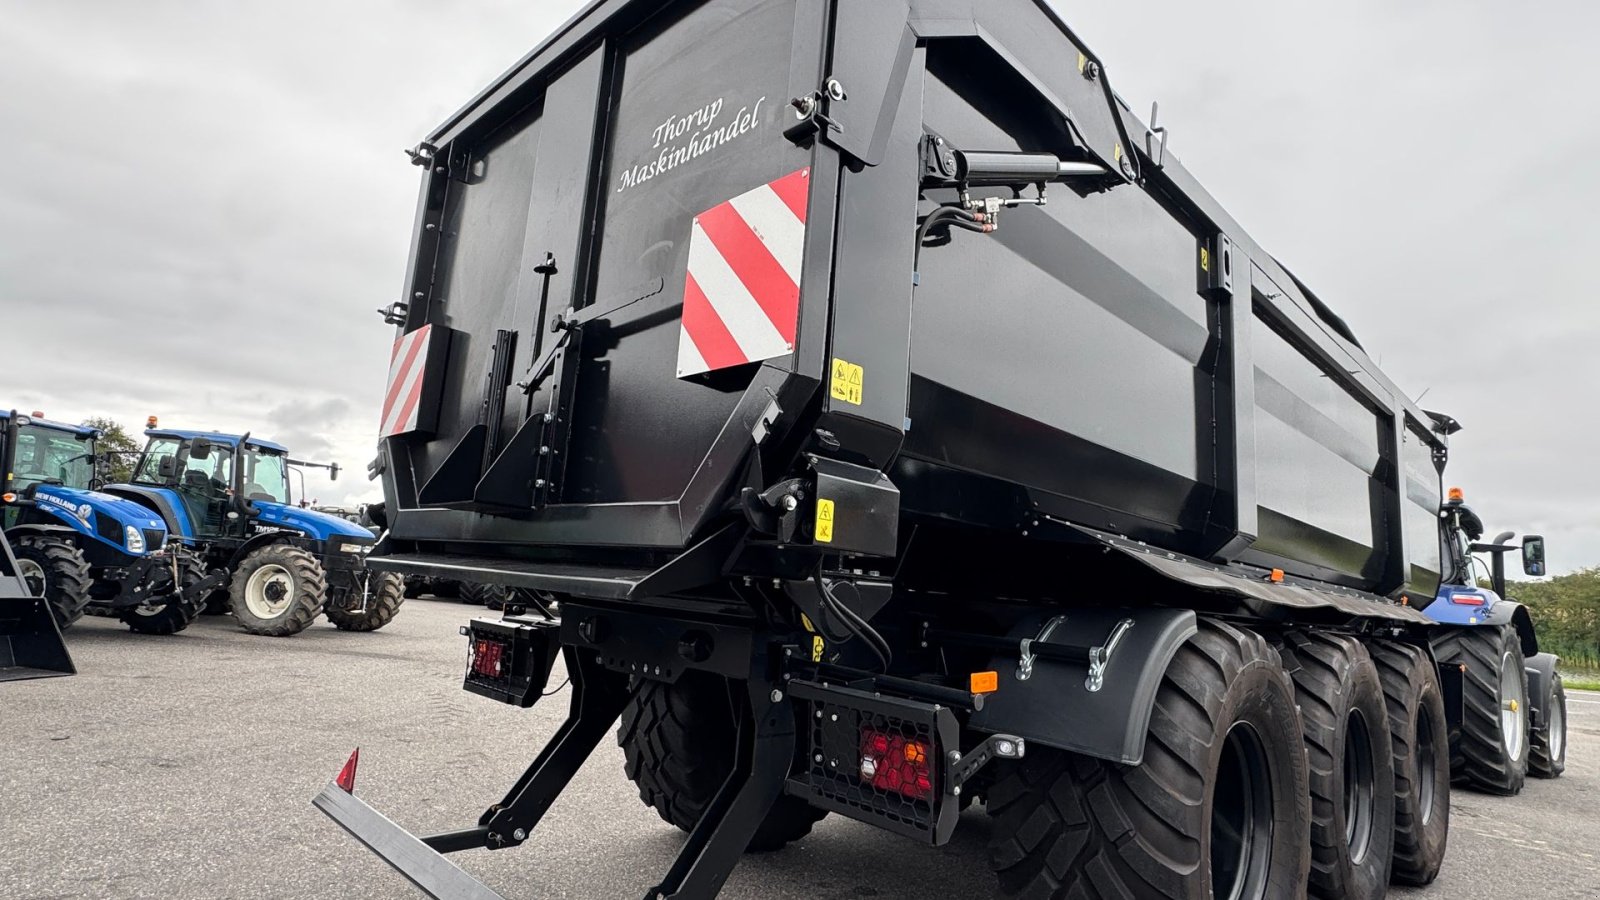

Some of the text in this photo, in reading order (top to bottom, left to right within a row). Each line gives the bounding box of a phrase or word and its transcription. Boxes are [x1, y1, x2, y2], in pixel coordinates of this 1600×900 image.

[616, 96, 766, 193] Maskinhandel
[652, 97, 723, 149] Thorup
[35, 491, 50, 501] NEW
[48, 495, 77, 511] HOLLAND
